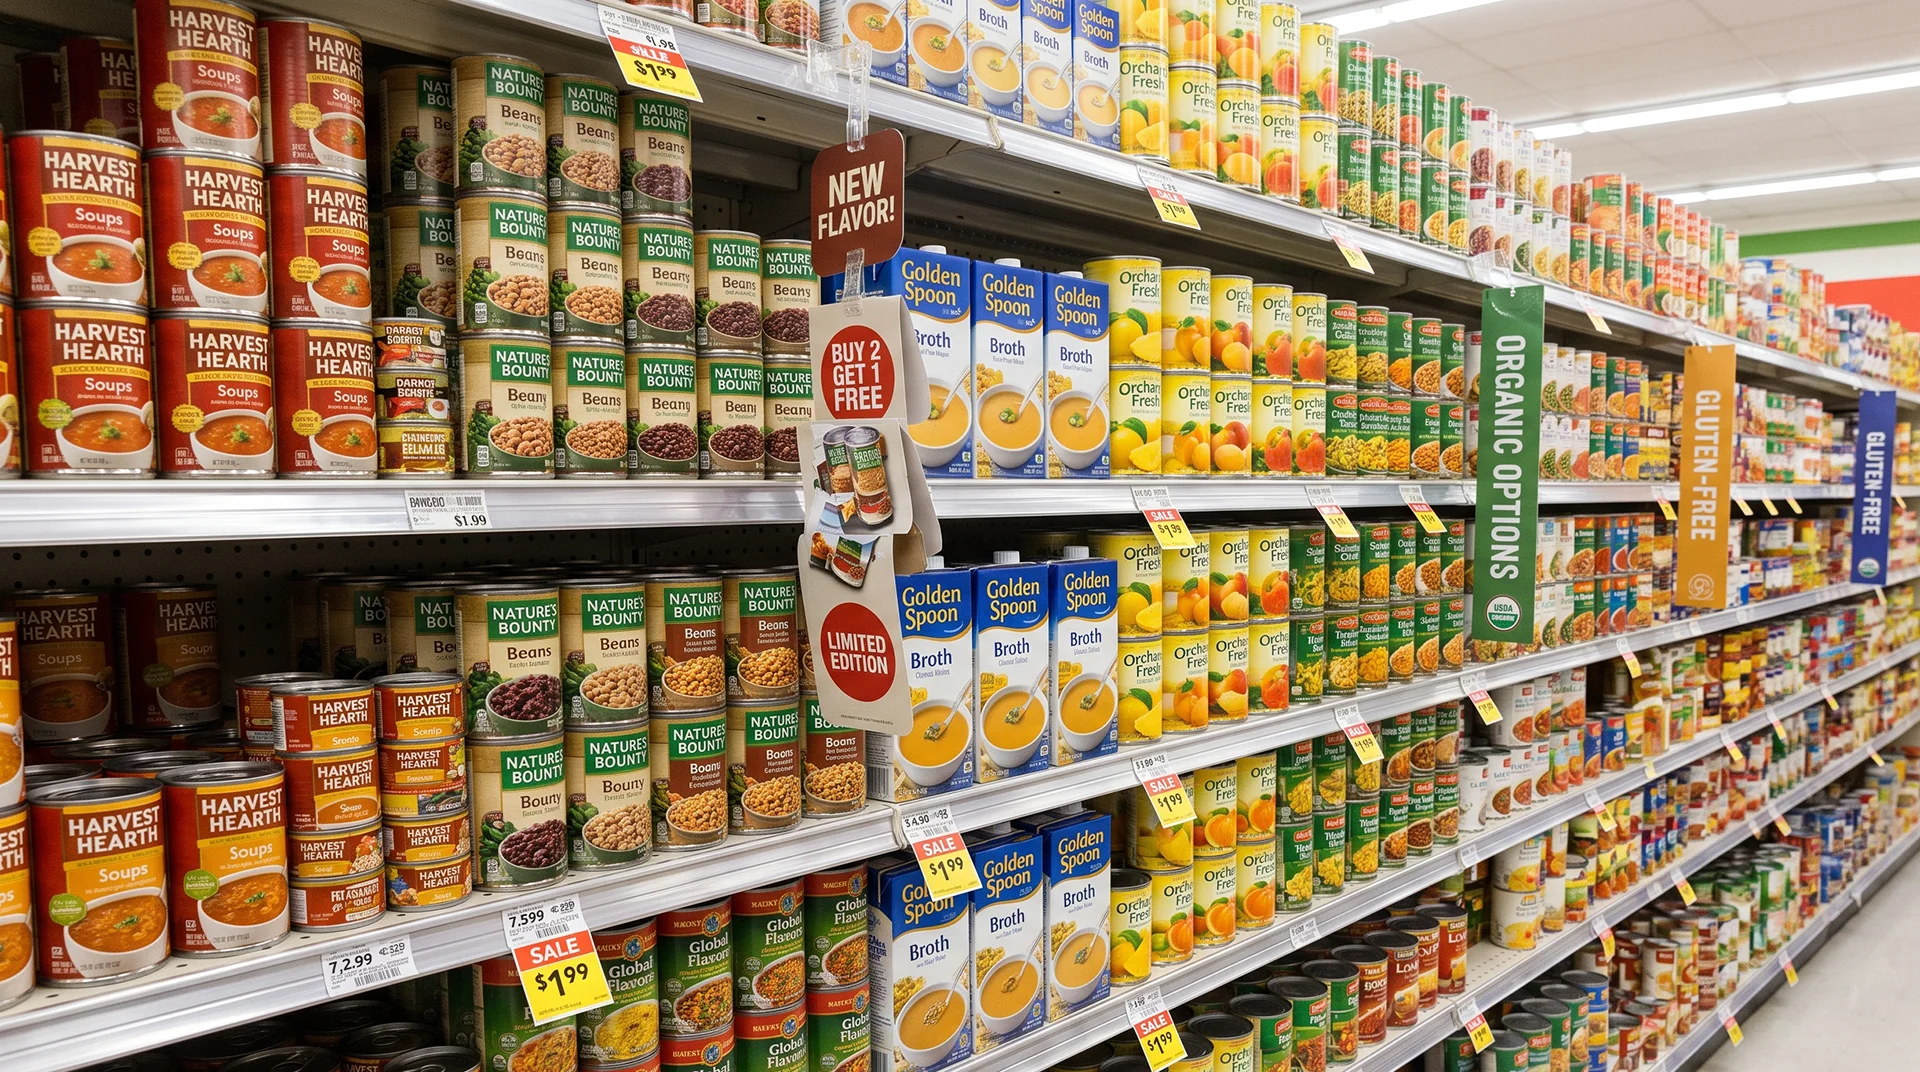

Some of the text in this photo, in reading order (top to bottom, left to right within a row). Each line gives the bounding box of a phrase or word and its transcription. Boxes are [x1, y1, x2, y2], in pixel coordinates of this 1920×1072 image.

[170, 9, 255, 44] HARVEST
[979, 8, 1008, 30] Broth
[1078, 5, 1114, 30] Golden
[1081, 18, 1113, 42] Spoon
[177, 28, 252, 60] HEARTH
[1034, 30, 1060, 51] Broth
[1084, 50, 1108, 70] Broth
[198, 64, 242, 86] Soups
[1132, 75, 1165, 89] Fresh
[332, 87, 362, 110] Soups
[495, 83, 544, 102] BOUNTY
[501, 104, 542, 127] Beans
[570, 99, 618, 121] BOUNTY
[639, 103, 688, 122] NATURES
[576, 122, 616, 142] Beans
[642, 115, 688, 132] BOUNTY
[648, 137, 685, 155] Beans
[44, 150, 137, 181] HARVEST
[52, 170, 136, 200] HEARTH
[185, 169, 264, 198] HARVEST
[828, 160, 886, 208] NEW
[192, 188, 262, 216] HEARTH
[75, 208, 124, 227] Soups
[314, 207, 369, 232] HEARTH
[818, 195, 895, 240] FLAVOR!
[213, 223, 254, 242] Soups
[500, 222, 546, 241] BOUNTY
[332, 239, 365, 256] Soups
[576, 234, 621, 252] BOUNTY
[643, 233, 692, 251] NATURES
[712, 243, 760, 260] NATURES
[647, 245, 691, 262] BOUNTY
[716, 254, 758, 270] BOUNTY
[580, 258, 618, 275] Beans
[901, 258, 961, 287] Golden
[722, 276, 756, 292] Beans
[982, 272, 1035, 298] Golden
[904, 280, 956, 309] Spoon
[1054, 284, 1100, 308] Golden
[985, 294, 1030, 318] Spoon
[1056, 304, 1098, 328] Spoon
[54, 322, 146, 346] HARVEST
[189, 332, 268, 356] HARVEST
[62, 343, 145, 365] HEARTH
[832, 340, 881, 364] BUY 2
[990, 336, 1026, 358] Broth
[1060, 346, 1093, 365] Broth
[197, 351, 268, 373] HEARTH
[496, 350, 550, 366] NATURES
[572, 356, 624, 372] NATURES
[316, 358, 374, 379] HEARTH
[502, 364, 550, 380] BOUNTY
[576, 369, 624, 384] BOUNTY
[643, 363, 694, 376] NATURES
[714, 368, 762, 381] NATURES
[832, 362, 880, 386] GET 1
[84, 377, 132, 395] Soups
[648, 374, 694, 388] BOUNTY
[719, 378, 762, 392] BOUNTY
[218, 383, 259, 402] Soups
[334, 389, 368, 406] Soups
[582, 392, 622, 406] Beans
[834, 386, 884, 412] FREE
[1132, 394, 1160, 408] Fresh
[1488, 334, 1526, 580] ORGANIC OPTIONS
[1690, 390, 1722, 541] GLUTEN-FREE
[1862, 432, 1886, 536] GLUTEN-FREE
[454, 514, 487, 527] $1.99
[986, 576, 1040, 602] Golden
[1064, 572, 1110, 595] Golden
[670, 591, 722, 606] NATURES
[902, 584, 961, 612] Golden
[1066, 590, 1106, 613] Spoon
[1494, 604, 1513, 612] USDA
[16, 607, 98, 626] HARVEST
[592, 610, 644, 626] BOUNTY
[673, 603, 722, 618] BOUNTY
[905, 606, 958, 632] Spoon
[990, 598, 1037, 624] Spoon
[22, 623, 96, 641] HEARTH
[498, 618, 556, 635] BOUNTY
[684, 628, 716, 640] Beans
[758, 620, 790, 632] Beans
[600, 636, 640, 650] Beans
[828, 630, 886, 654] LIMITED
[1070, 626, 1102, 648] Broth
[507, 645, 552, 660] Beans
[993, 637, 1030, 659] Broth
[38, 652, 82, 667] Soups
[830, 648, 888, 674] EDITION
[910, 648, 952, 670] Broth
[312, 698, 370, 715] HARVEST
[398, 692, 452, 708] HARVEST
[319, 710, 368, 726] HEARTH
[402, 704, 450, 718] HEARTH
[750, 713, 798, 729] NATURES
[754, 725, 798, 742] BOUNTY
[396, 750, 441, 761] HARVEST
[678, 738, 726, 755] BOUNTY
[317, 759, 374, 778] HARVEST
[401, 759, 439, 770] HEARTH
[506, 750, 564, 772] NATURES
[594, 752, 647, 770] BOUNTY
[323, 772, 372, 791] HEARTH
[511, 764, 564, 785] BOUNTY
[1150, 777, 1176, 793] SALE
[202, 788, 282, 817] HARVEST
[68, 806, 160, 838] HARVEST
[209, 808, 282, 834] HEARTH
[76, 824, 160, 855] HEARTH
[407, 824, 452, 839] HARVEST
[411, 834, 450, 846] HEARTH
[230, 842, 274, 860] Soups
[300, 840, 346, 852] HARVEST
[922, 838, 956, 856] SALE
[1058, 832, 1104, 856] Golden
[303, 850, 343, 860] HEARTH
[983, 852, 1035, 878] Golden
[1060, 847, 1100, 874] Spoon
[98, 864, 150, 884] Soups
[420, 865, 462, 881] HARVEST
[986, 871, 1032, 899] Spoon
[1063, 885, 1096, 908] Broth
[508, 910, 544, 928] 7.599
[766, 912, 802, 932] Global
[989, 908, 1025, 934] Broth
[530, 937, 580, 964] SALE
[689, 932, 728, 954] Global
[910, 936, 950, 962] Broth
[609, 957, 653, 981] Global
[1140, 1014, 1168, 1034] SALE
